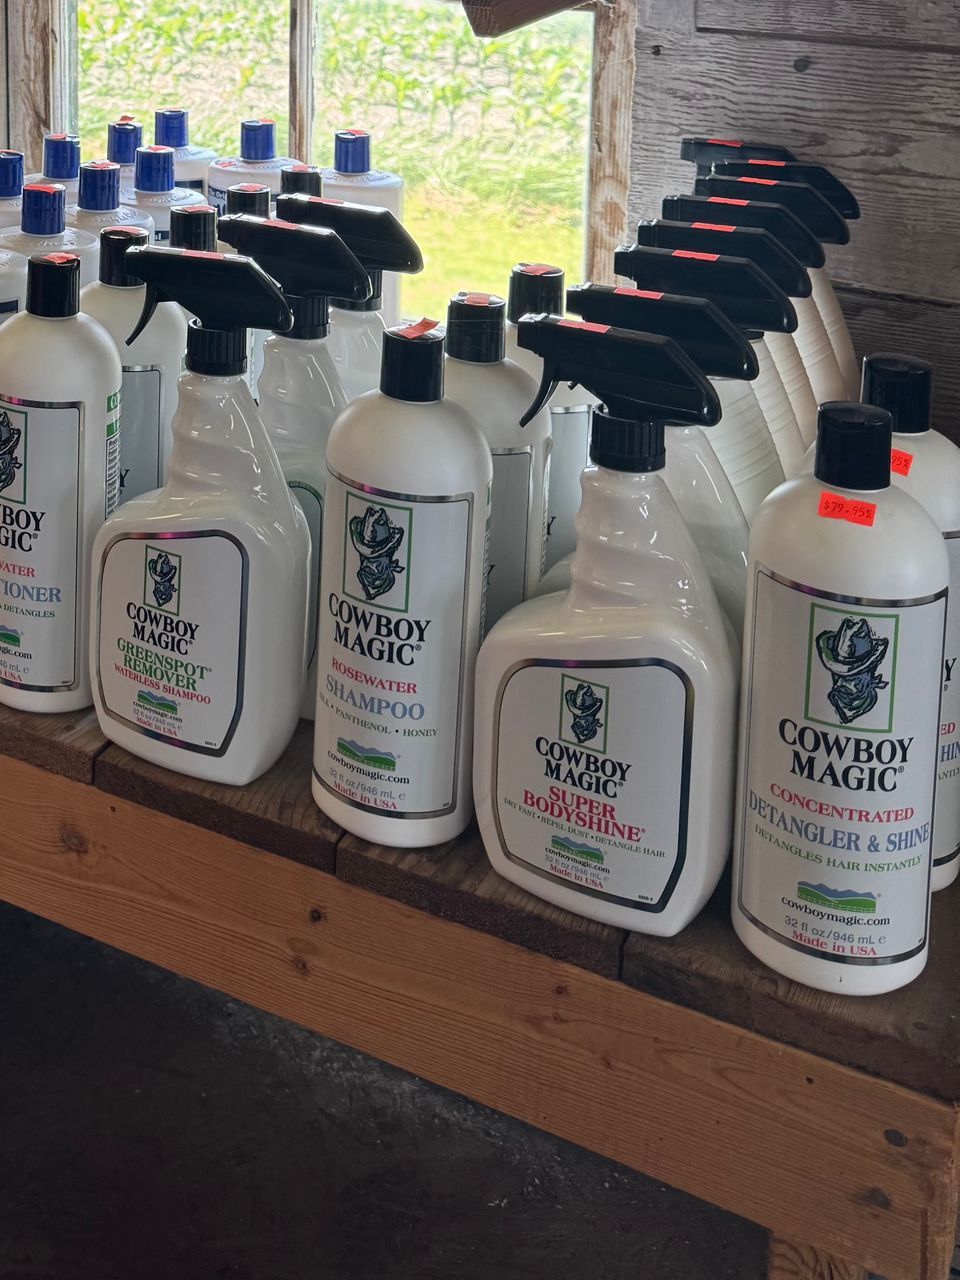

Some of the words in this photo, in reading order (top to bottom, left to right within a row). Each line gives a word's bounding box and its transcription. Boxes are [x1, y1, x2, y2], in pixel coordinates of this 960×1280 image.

[4, 604, 55, 618] DETANGLES
[127, 602, 199, 640] COWBOY
[328, 592, 432, 642] COWBOY
[3, 668, 22, 682] USA
[114, 663, 160, 691] WATERLESS
[163, 684, 211, 704] SHAMPOO
[123, 654, 197, 691] REMOVER
[332, 657, 417, 694] ROSEWATER
[133, 701, 183, 723] cowboymagic.com
[326, 674, 425, 721] SHAMPOO
[163, 727, 177, 736] USA
[335, 706, 391, 735] PANTHENOL
[403, 728, 439, 737] HONEY
[535, 736, 631, 782] COWBOY
[778, 718, 915, 765] COWBOY
[327, 749, 410, 785] cowboymagic.com
[329, 767, 338, 780] 32
[374, 795, 398, 810] USA
[549, 786, 616, 820] SUPER
[769, 782, 915, 823] CONCENTRATED
[504, 797, 517, 809] DRY
[518, 805, 537, 818] FAST
[568, 827, 590, 839] DUST
[595, 835, 642, 853] DETANGLE
[643, 848, 666, 858] HAIR
[749, 789, 861, 852] DETANGLER
[868, 835, 881, 853] &
[885, 821, 930, 853] SHINE
[545, 847, 610, 874] cowboymagic.com
[755, 823, 823, 864] DETANGLES
[826, 856, 860, 871] HAIR
[864, 854, 923, 873] INSTANTLY
[585, 876, 604, 889] USA
[781, 896, 891, 927] cowboymagic.com
[784, 915, 799, 926] 32
[858, 933, 876, 946] mL
[792, 930, 828, 950] Made
[832, 941, 846, 955] in
[849, 944, 877, 956] USA
